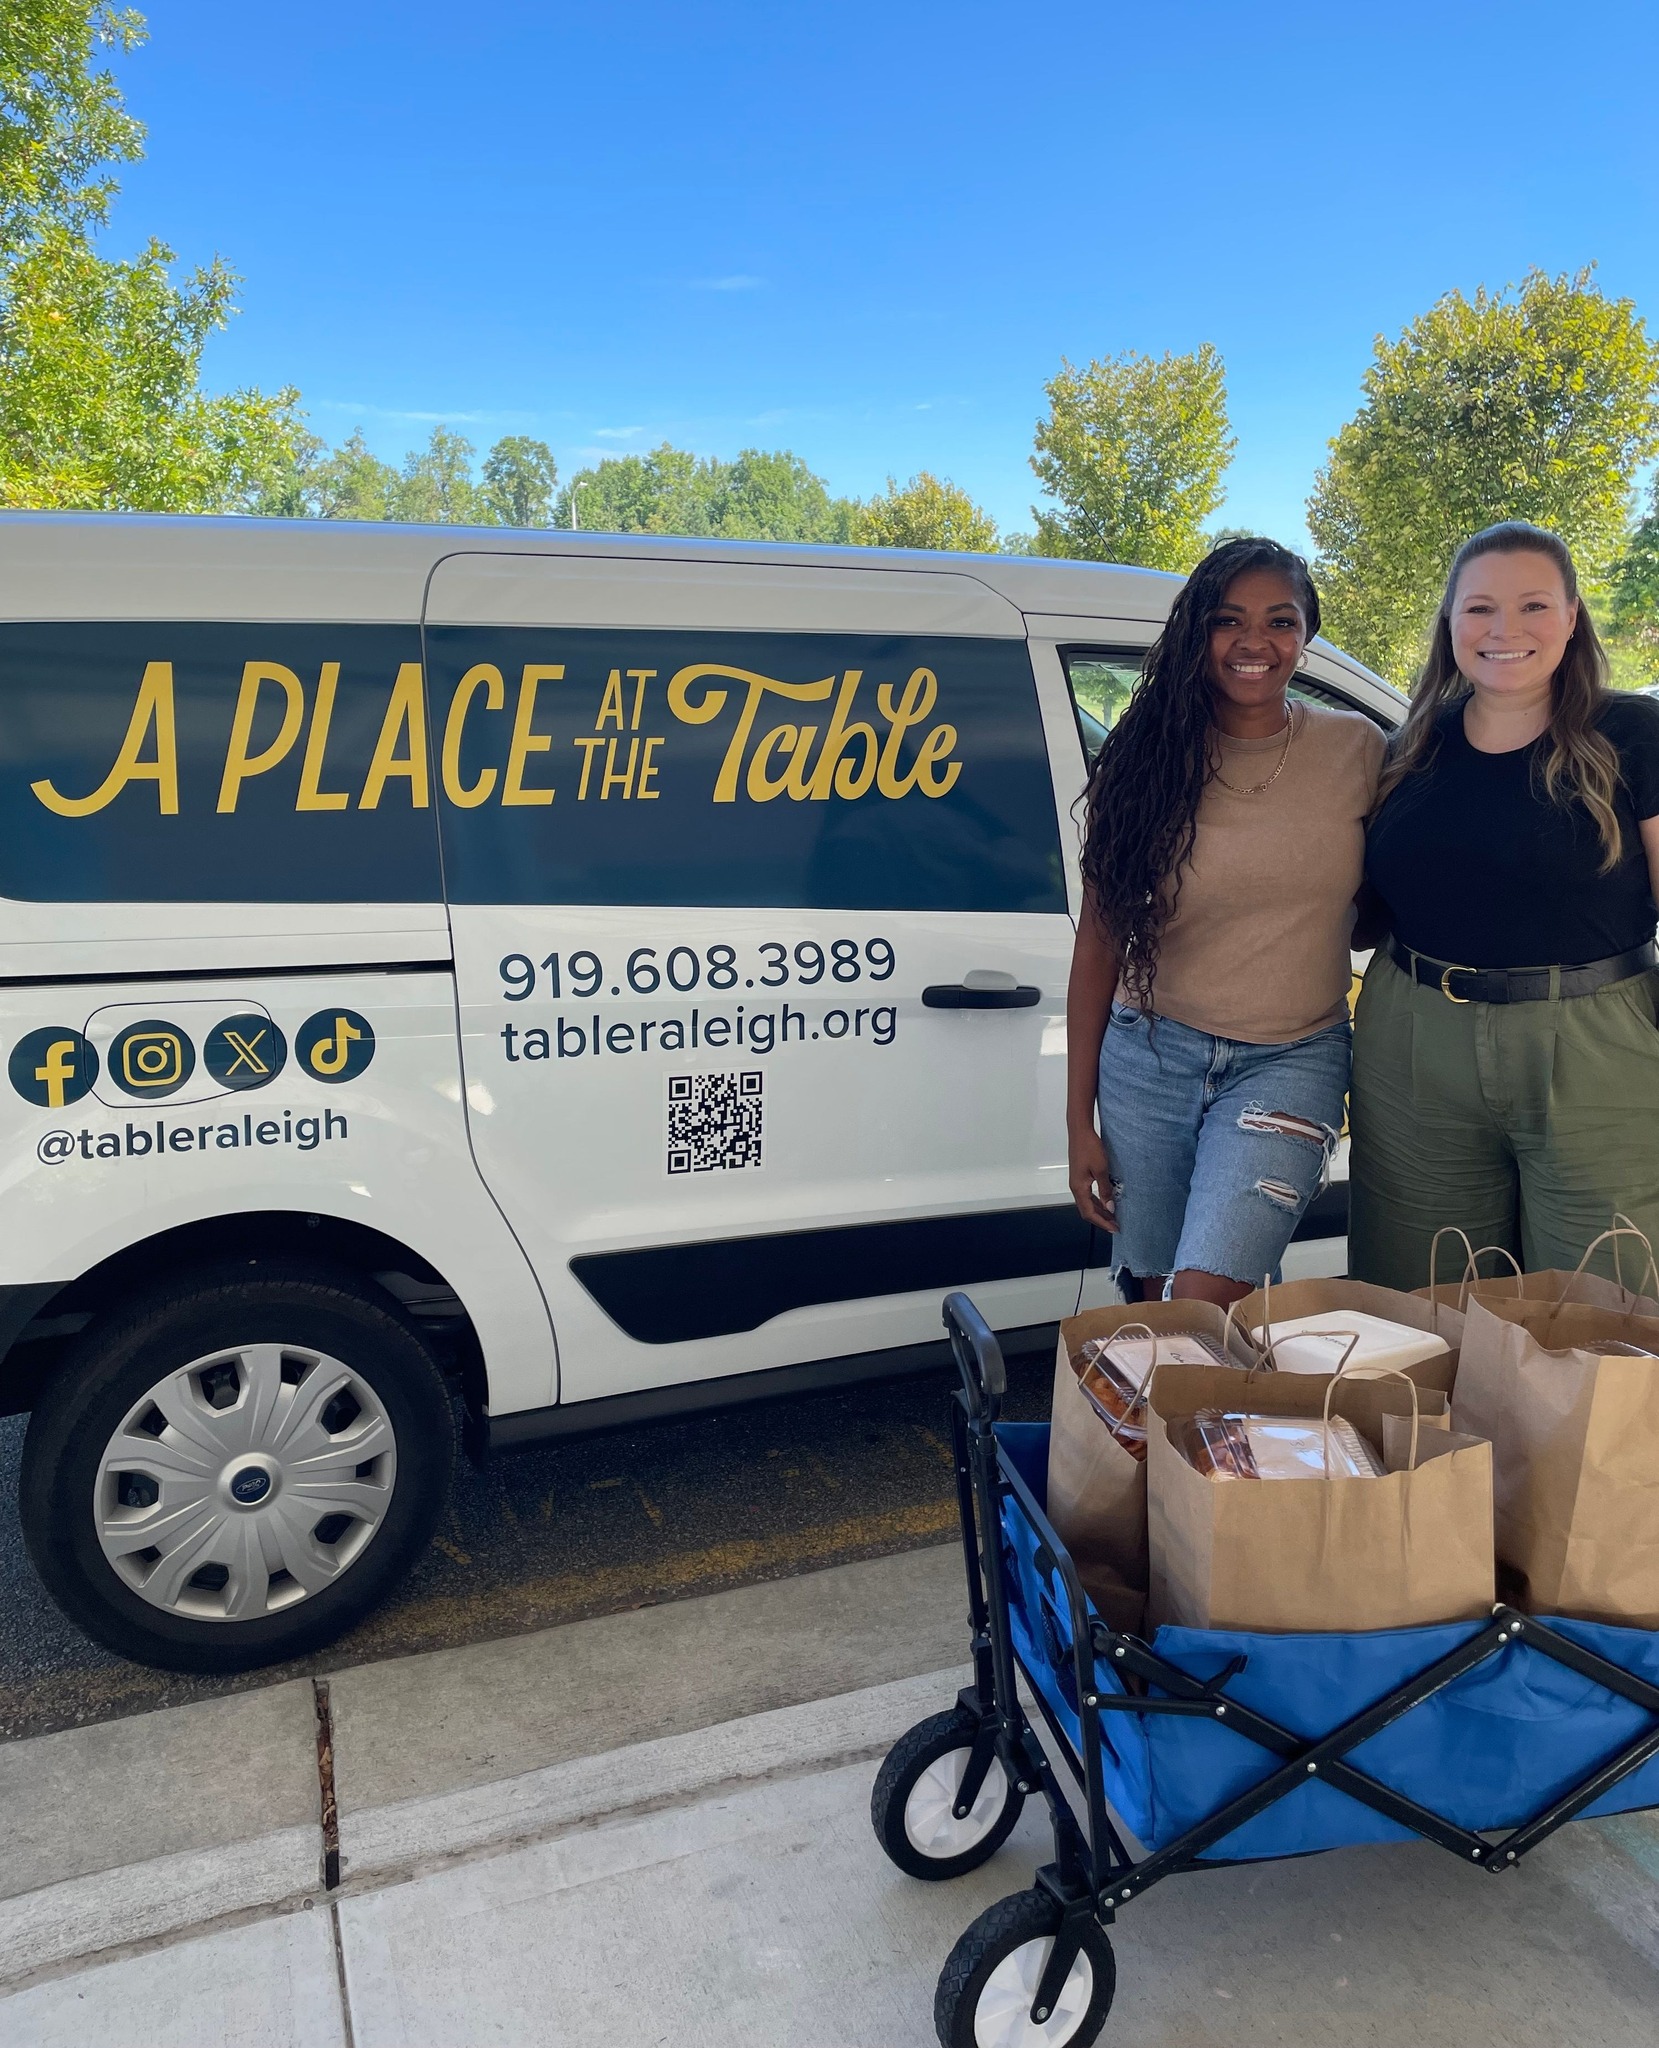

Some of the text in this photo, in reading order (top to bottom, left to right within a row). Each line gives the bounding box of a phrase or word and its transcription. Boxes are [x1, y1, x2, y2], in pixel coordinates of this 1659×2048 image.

[595, 669, 657, 731] AT
[31, 661, 179, 817] A
[216, 661, 565, 813] PLACE
[667, 664, 963, 803] Table
[574, 737, 665, 800] THE
[499, 937, 897, 1002] 919.608.3989
[500, 1003, 898, 1062] tableraleigh.org
[36, 1108, 349, 1166] @tableraleigh
